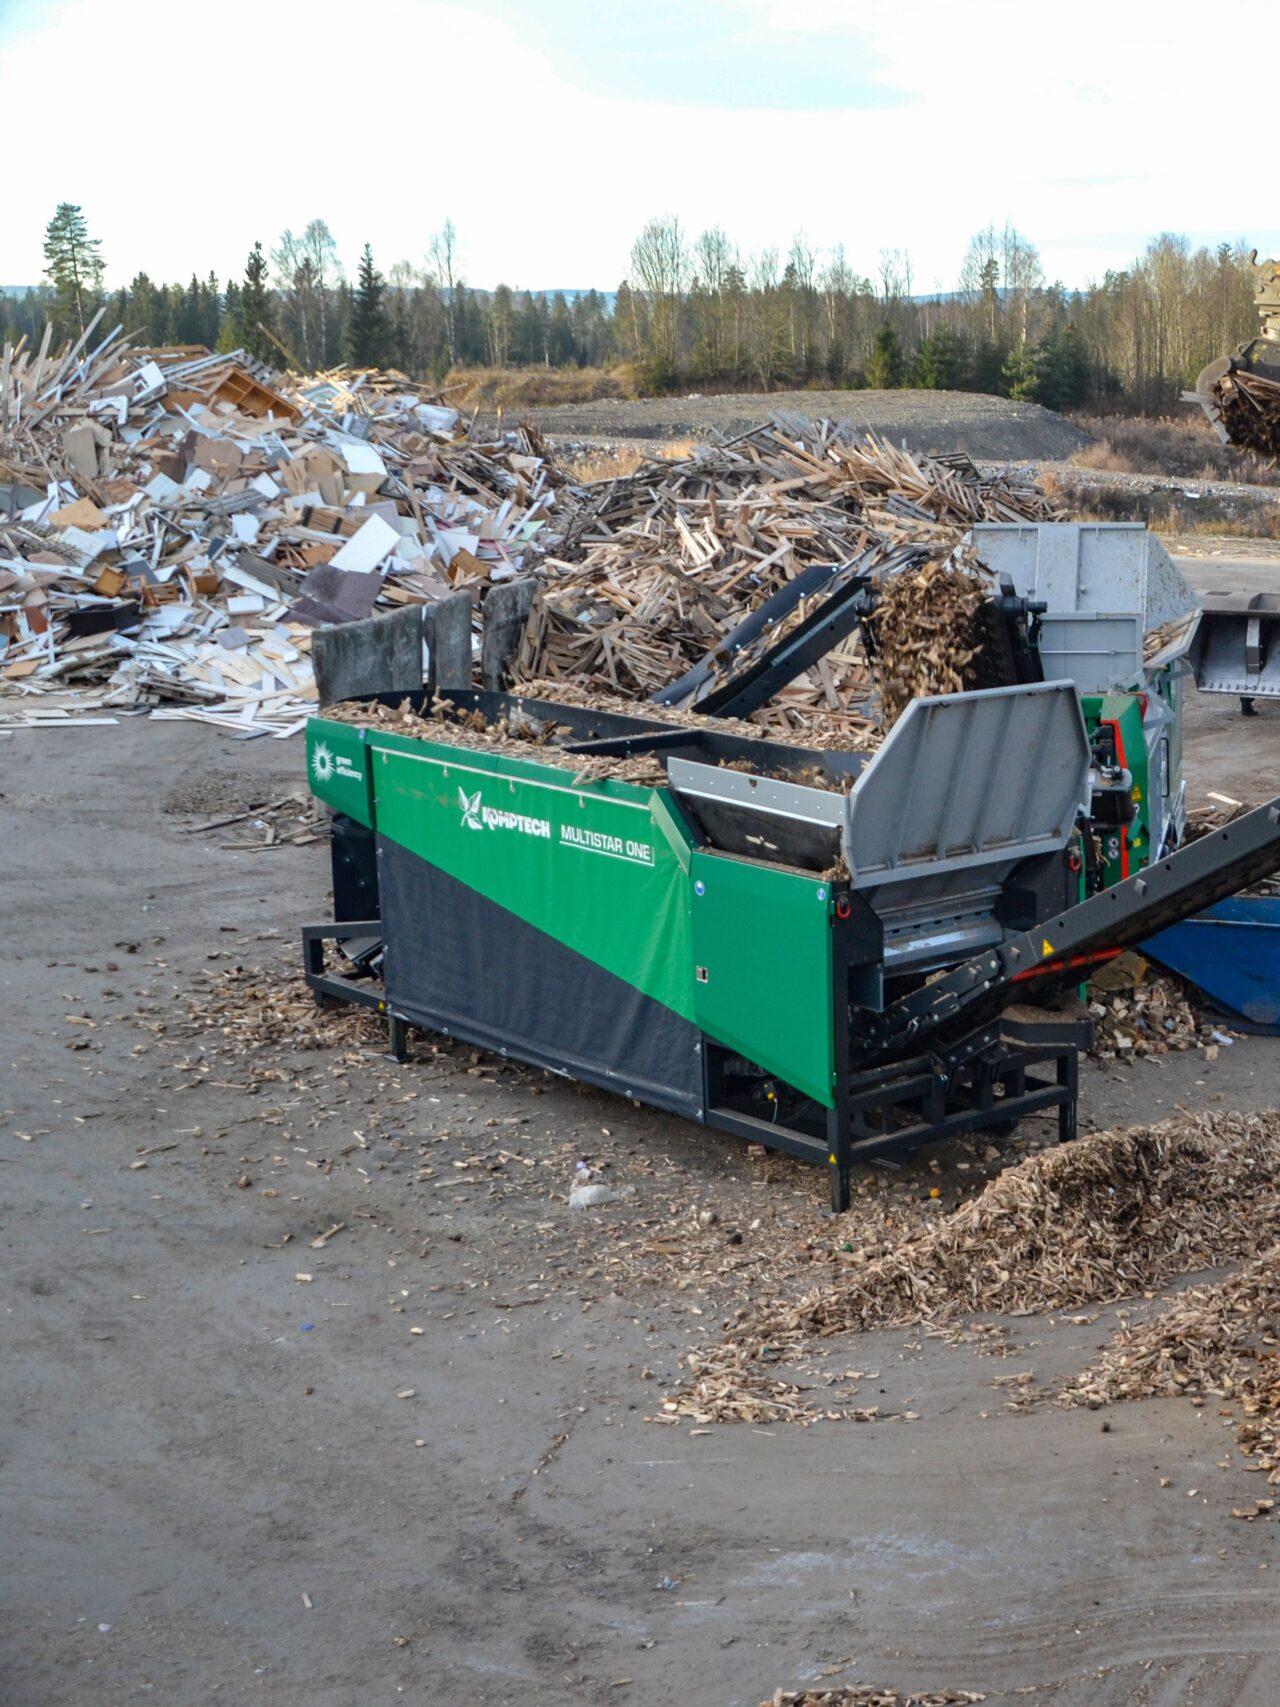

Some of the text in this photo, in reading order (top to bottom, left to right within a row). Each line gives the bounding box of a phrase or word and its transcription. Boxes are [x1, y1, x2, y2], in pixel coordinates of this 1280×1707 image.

[482, 806, 550, 838] KOMPTECH
[561, 824, 651, 860] MULTISTAR ONE
